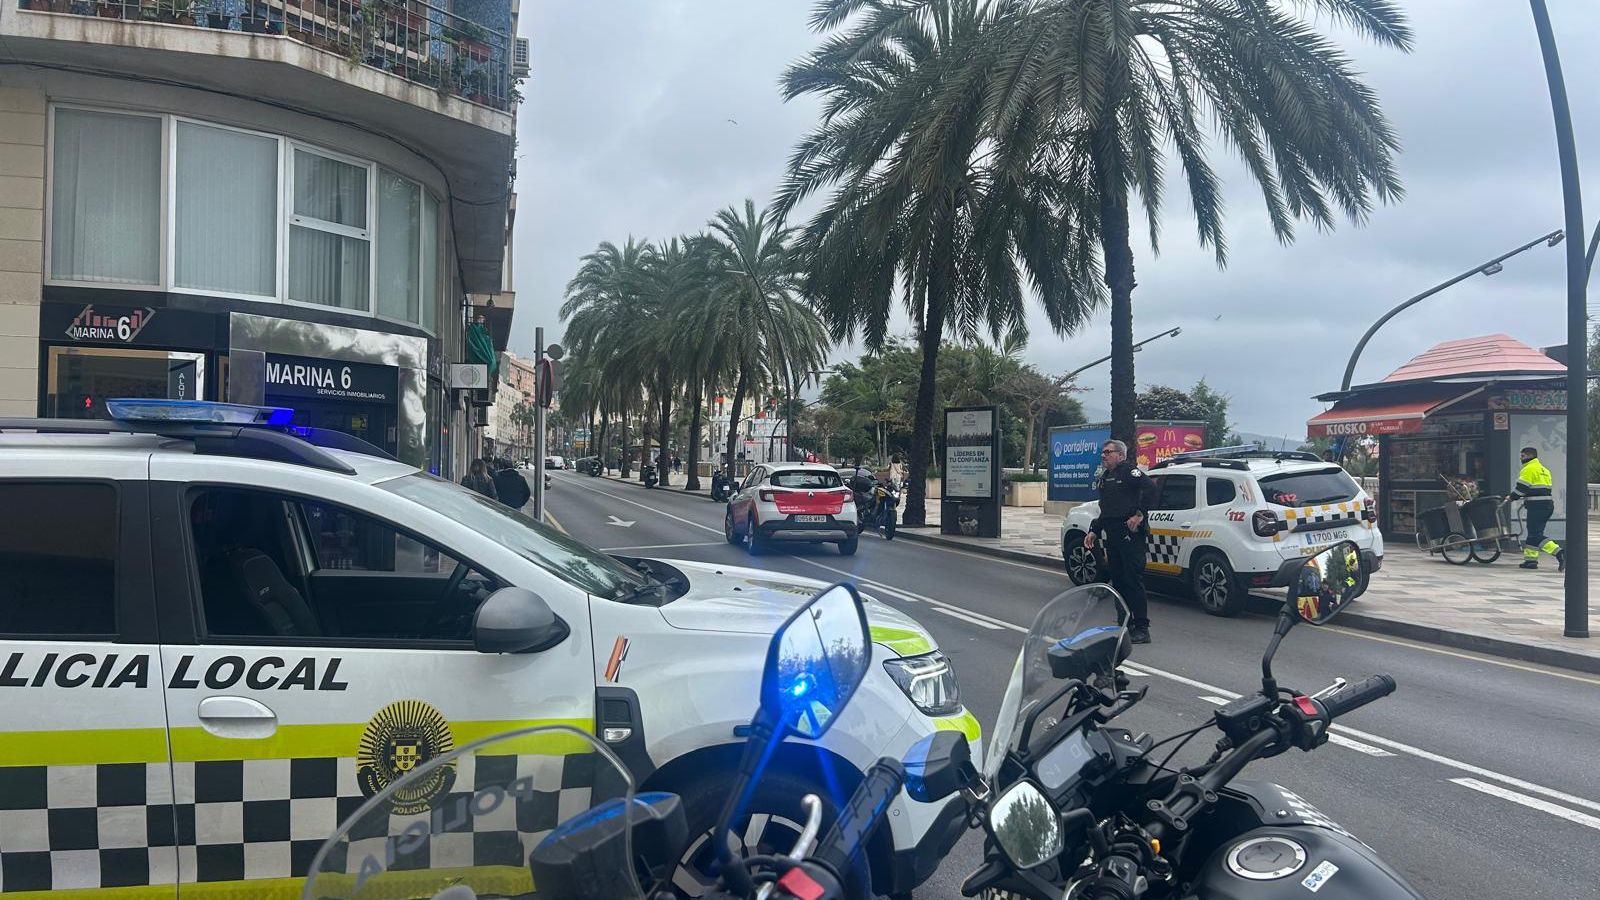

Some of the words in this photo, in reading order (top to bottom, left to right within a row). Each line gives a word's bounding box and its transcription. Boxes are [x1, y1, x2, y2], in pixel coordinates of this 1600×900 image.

[73, 326, 115, 340] MARINA
[117, 316, 131, 340] 6
[266, 362, 335, 388] MARINA
[341, 366, 352, 389] 6
[316, 388, 346, 397] SERVICIOS
[346, 390, 386, 400] INMOBILIARIOS
[1326, 422, 1367, 436] KIOSKO
[1063, 439, 1098, 455] portalferry
[1279, 493, 1297, 503] 112
[1150, 512, 1175, 522] LOCAL
[1228, 511, 1246, 522] 112
[1312, 532, 1333, 543] 1700
[168, 654, 351, 691] LOCAL
